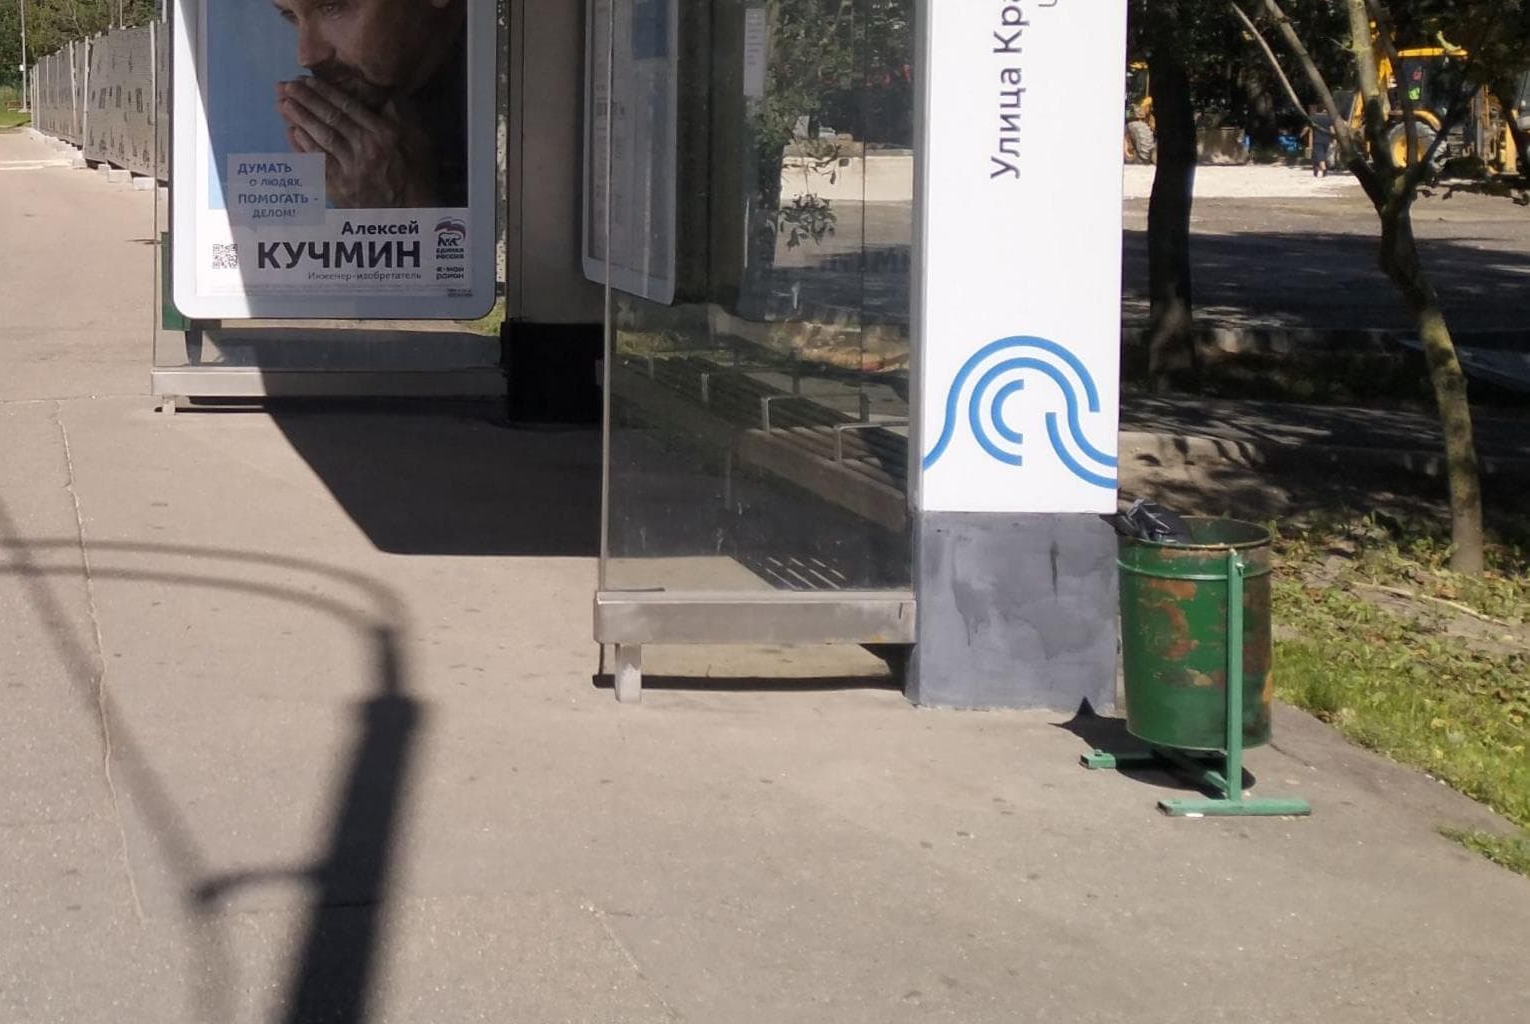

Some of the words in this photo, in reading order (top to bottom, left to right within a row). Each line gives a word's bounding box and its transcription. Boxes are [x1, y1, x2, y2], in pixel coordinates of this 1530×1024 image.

[990, 67, 1026, 179] Улица
[237, 162, 293, 176] ДУМАТЬ
[261, 178, 303, 188] ЛЮДЯХ,
[238, 192, 309, 205] ПОМОГАТЬ
[252, 208, 296, 220] ДЕЛОМ!
[341, 220, 419, 236] Алексей
[257, 240, 421, 270] КУЧМИН
